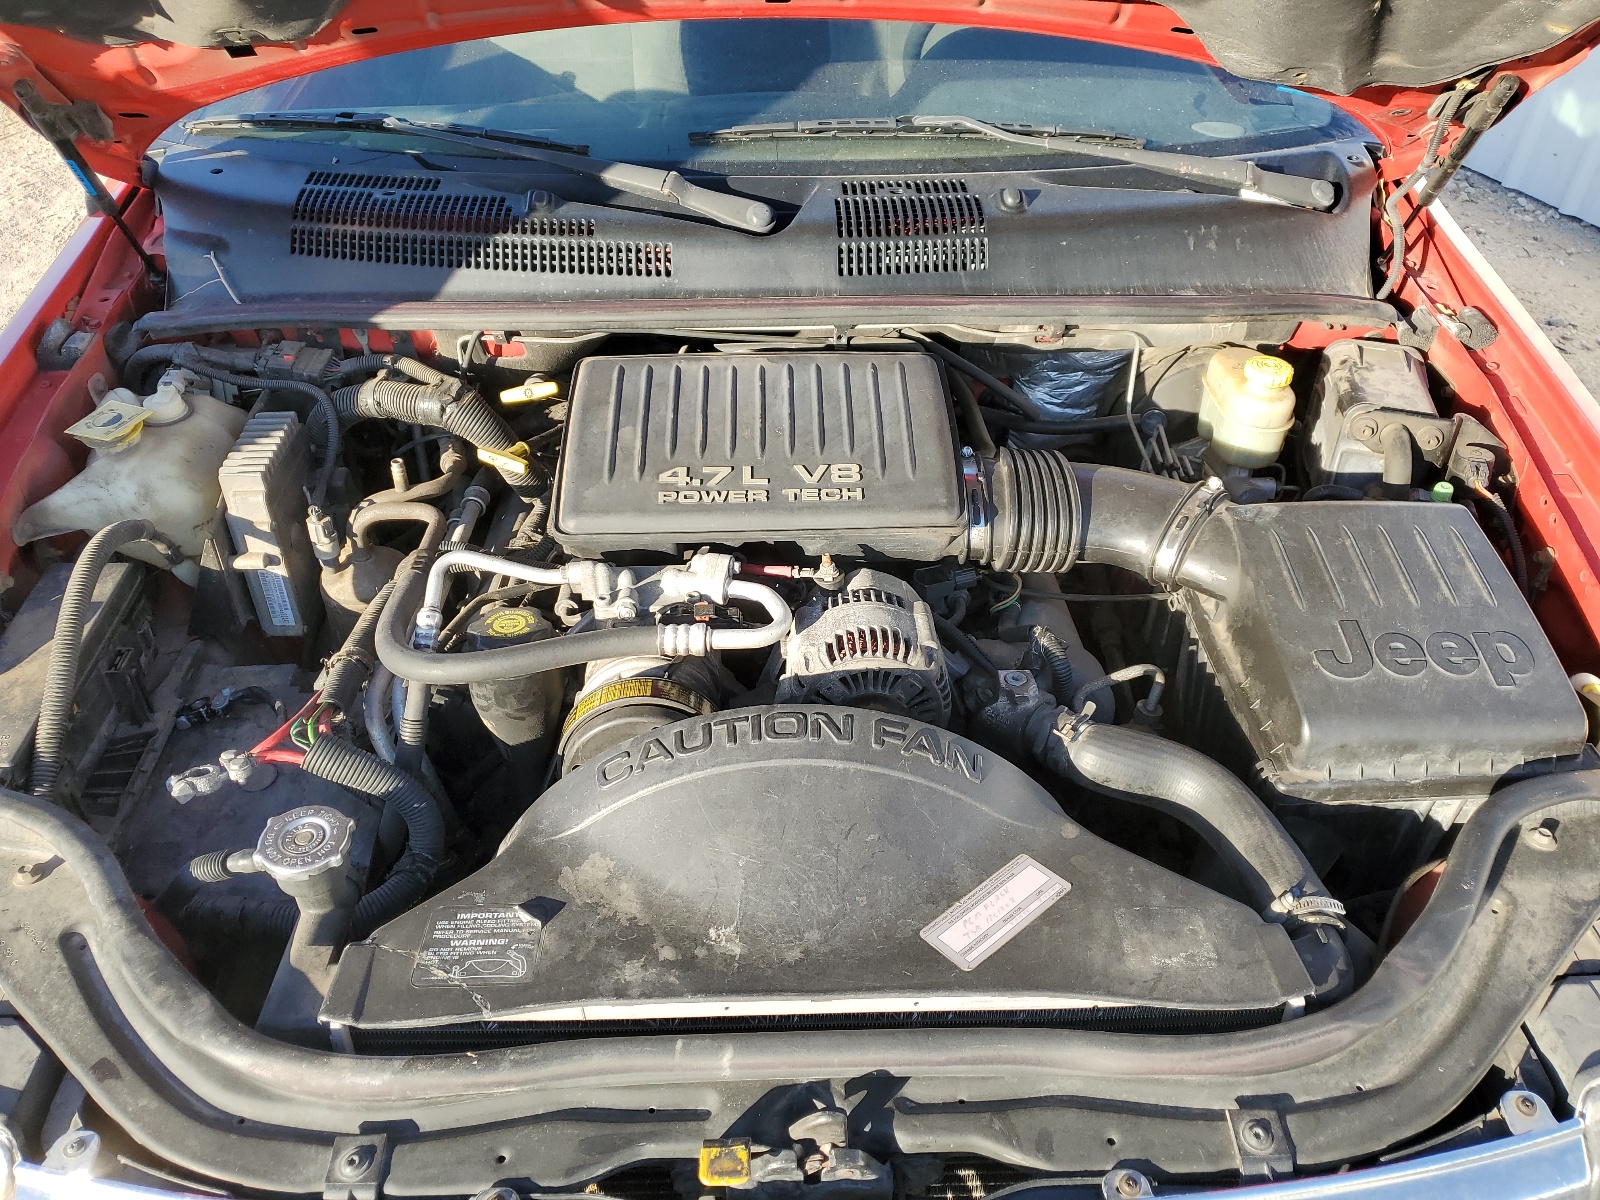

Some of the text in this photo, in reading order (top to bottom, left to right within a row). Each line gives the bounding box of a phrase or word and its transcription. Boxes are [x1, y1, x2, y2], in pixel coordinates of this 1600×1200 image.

[658, 463, 862, 486] 4.7 L V8
[658, 488, 865, 504] POWER TECH
[1312, 620, 1536, 689] Jeep
[596, 712, 984, 790] CAUTION FAN
